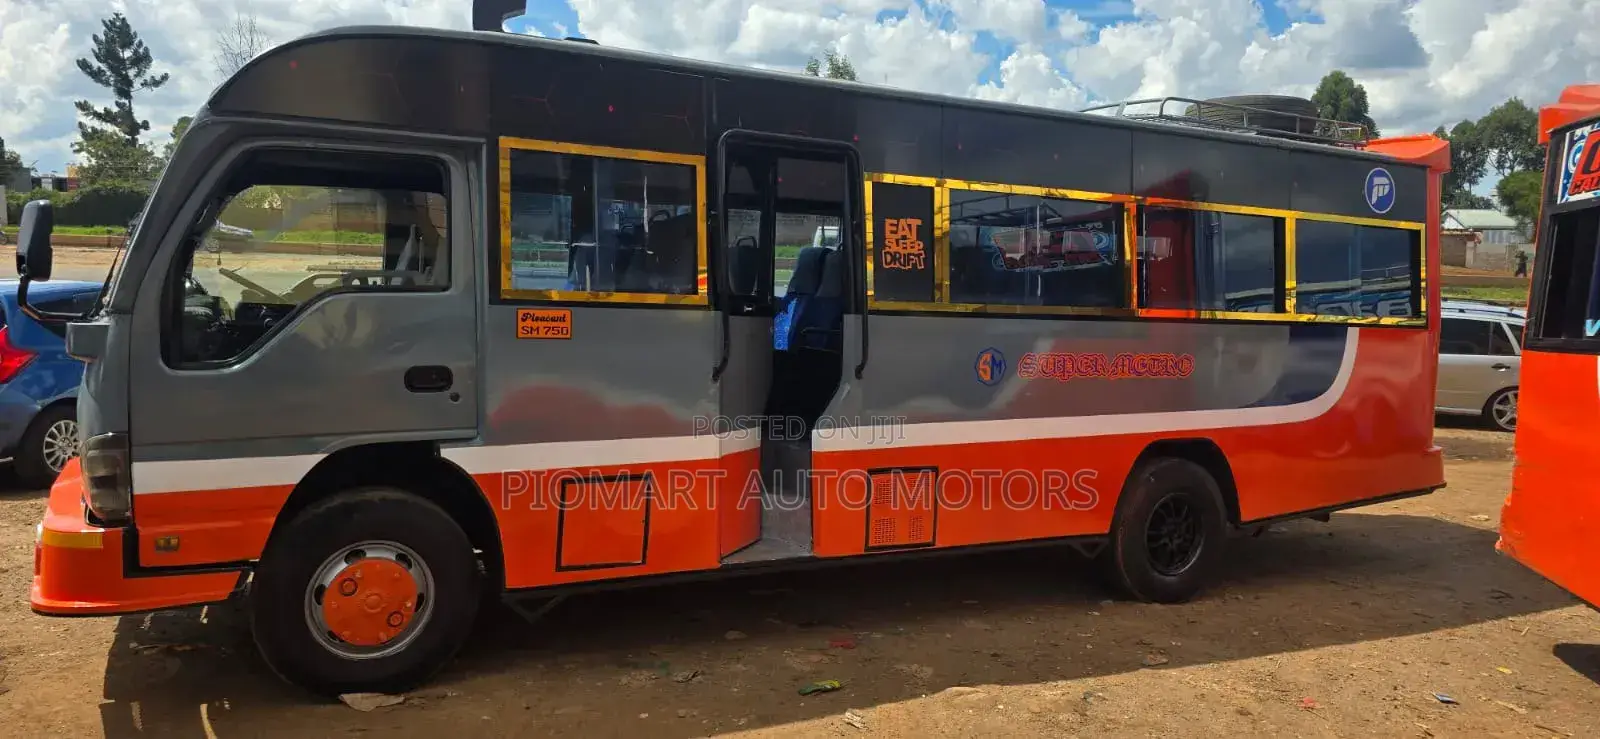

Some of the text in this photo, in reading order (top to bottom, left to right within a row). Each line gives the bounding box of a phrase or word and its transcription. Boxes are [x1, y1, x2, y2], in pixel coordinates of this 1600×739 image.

[884, 217, 922, 240] EAT
[885, 237, 924, 251] SLEEP
[882, 249, 926, 270] DRIFT
[520, 312, 567, 323] Pleasant
[520, 325, 569, 336] SM 750
[1018, 352, 1194, 381] SUPER METRO
